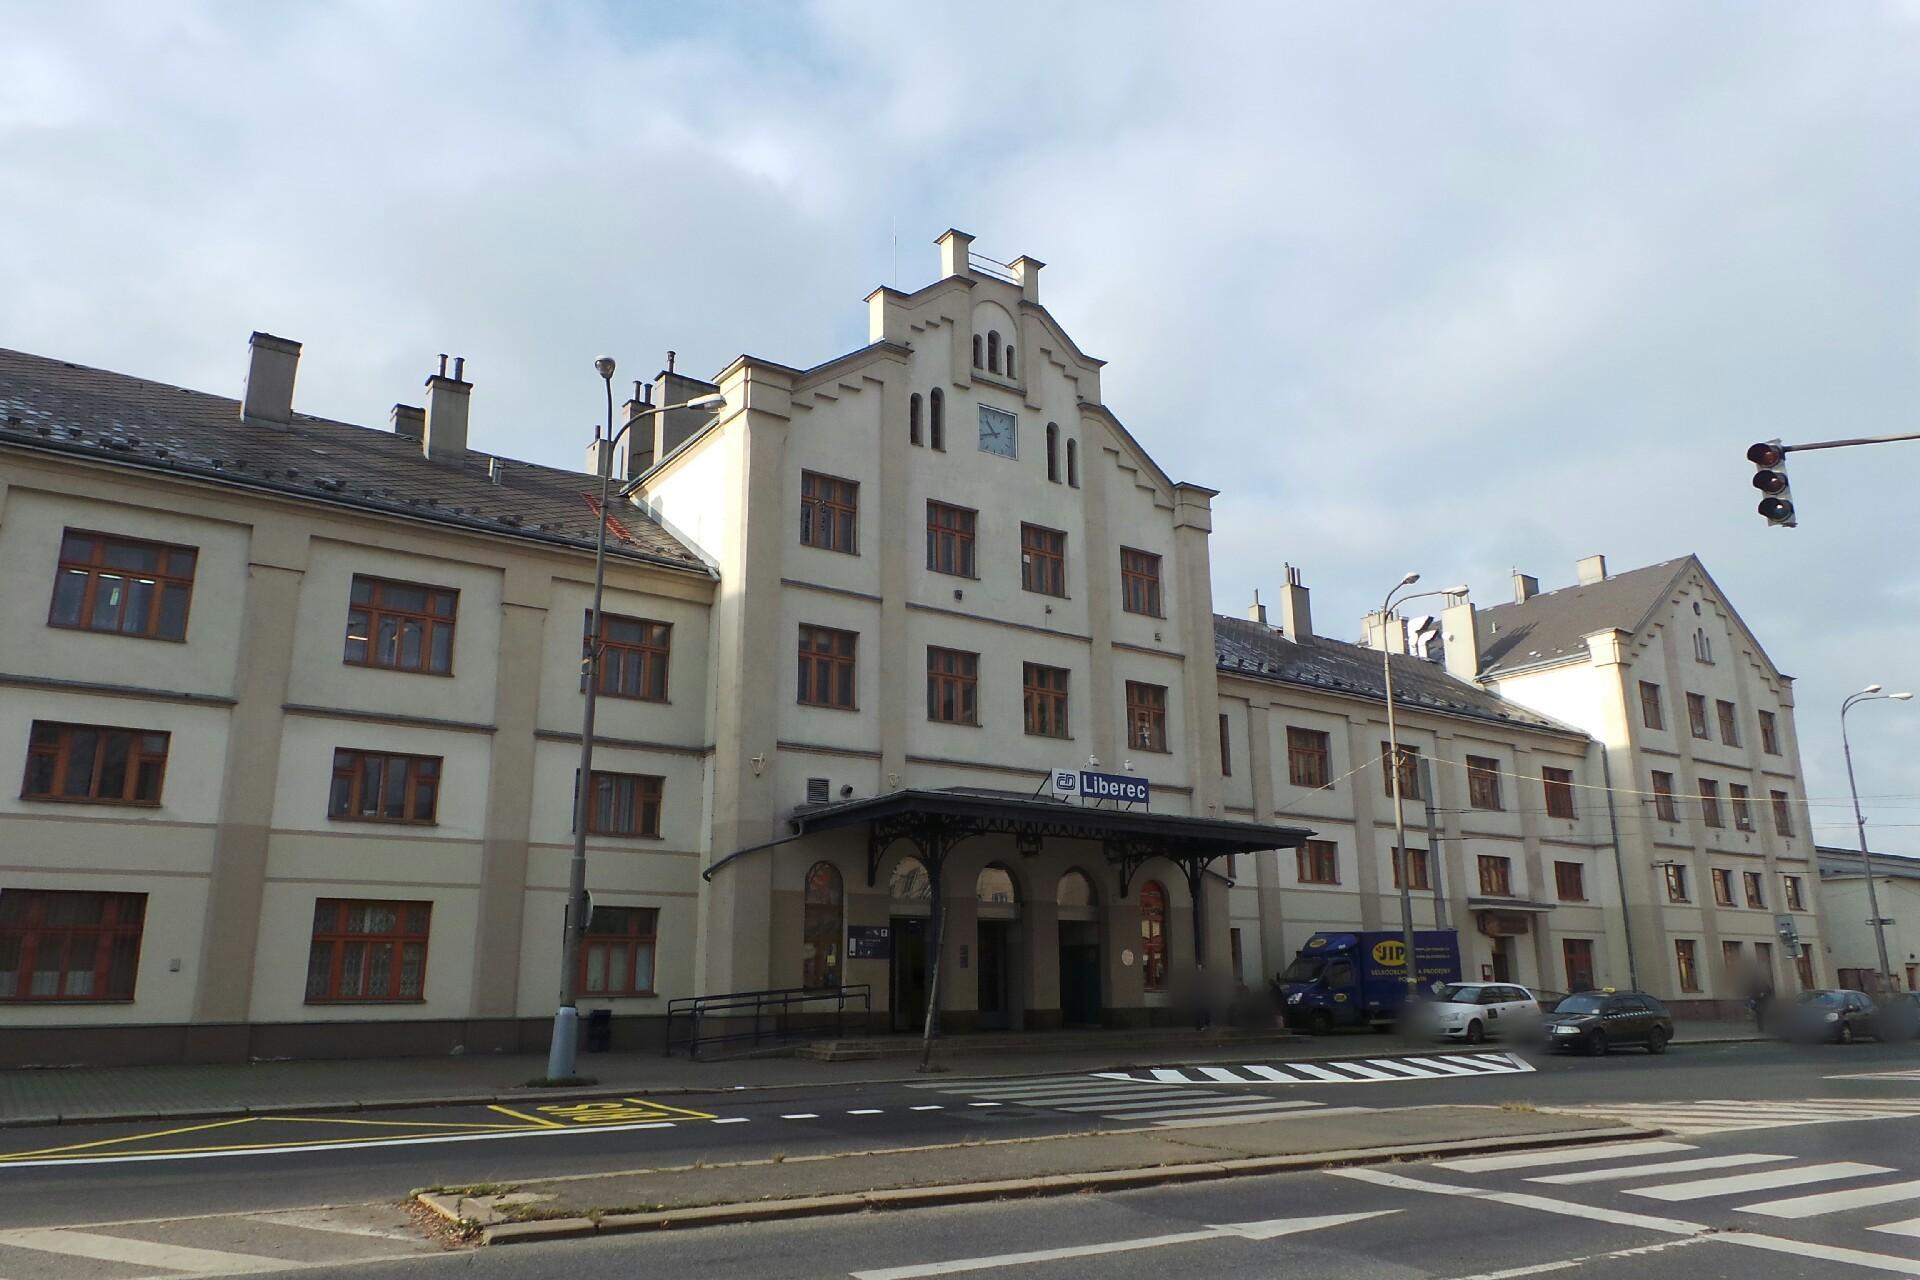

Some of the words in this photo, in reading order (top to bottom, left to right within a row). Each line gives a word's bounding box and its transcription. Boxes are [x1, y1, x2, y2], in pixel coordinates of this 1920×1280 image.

[1083, 774, 1146, 799] Liberec
[1379, 945, 1405, 961] JIP
[536, 1102, 669, 1122] BUS
